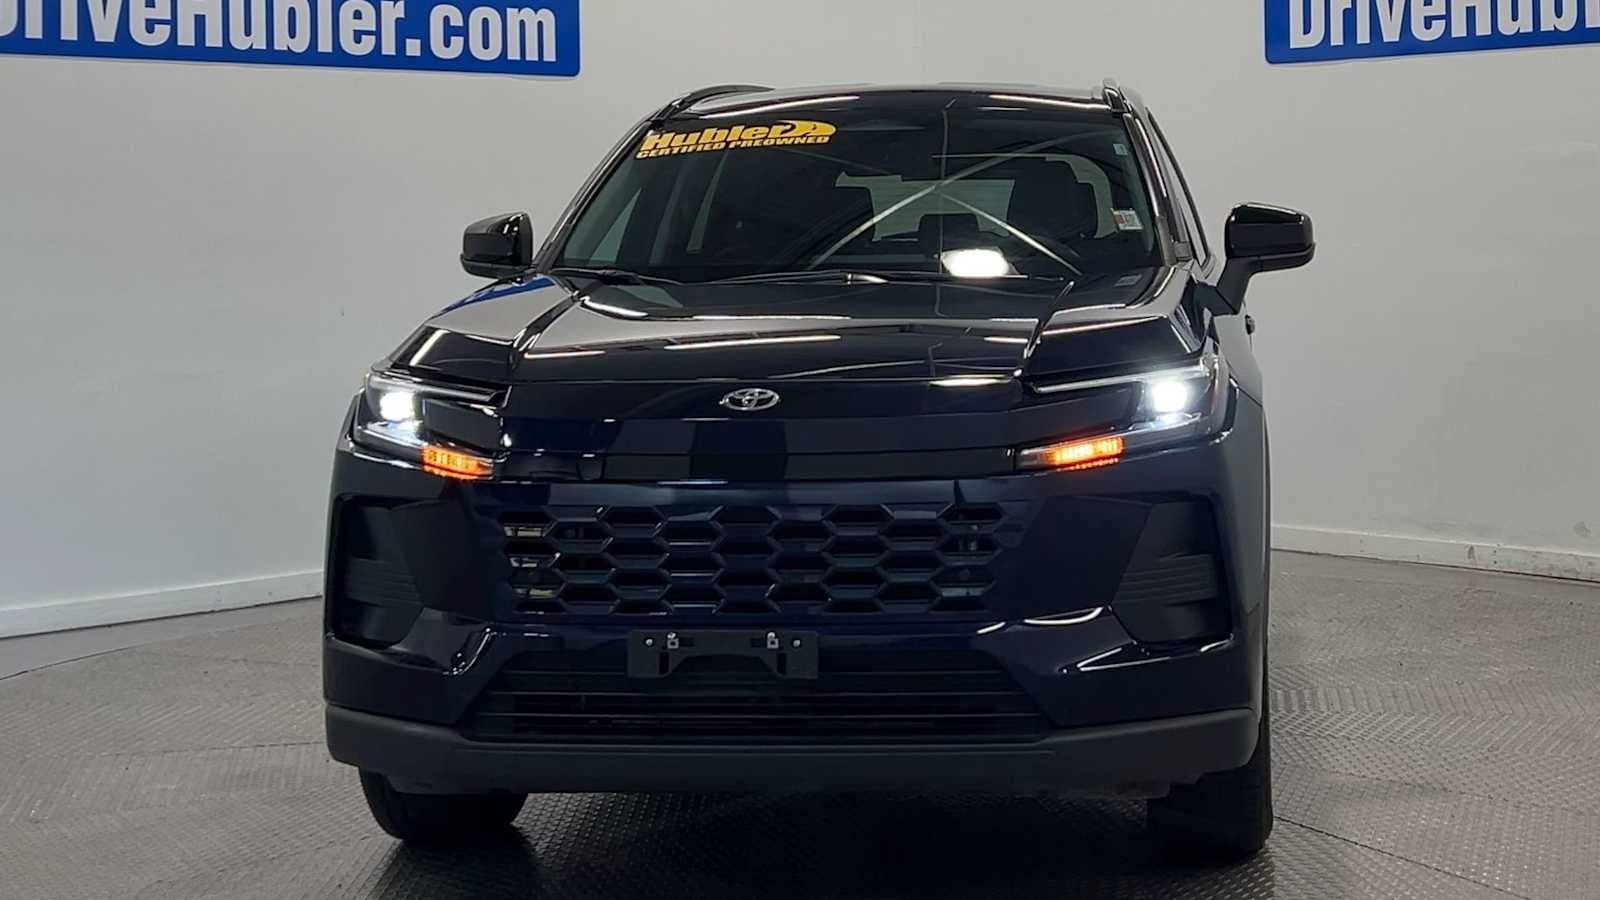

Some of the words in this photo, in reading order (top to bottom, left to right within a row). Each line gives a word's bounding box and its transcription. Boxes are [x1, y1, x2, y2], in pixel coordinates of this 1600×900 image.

[635, 142, 726, 159] CERTIFIED
[728, 136, 831, 149] PREOWNED
[641, 124, 794, 150] Hubler
